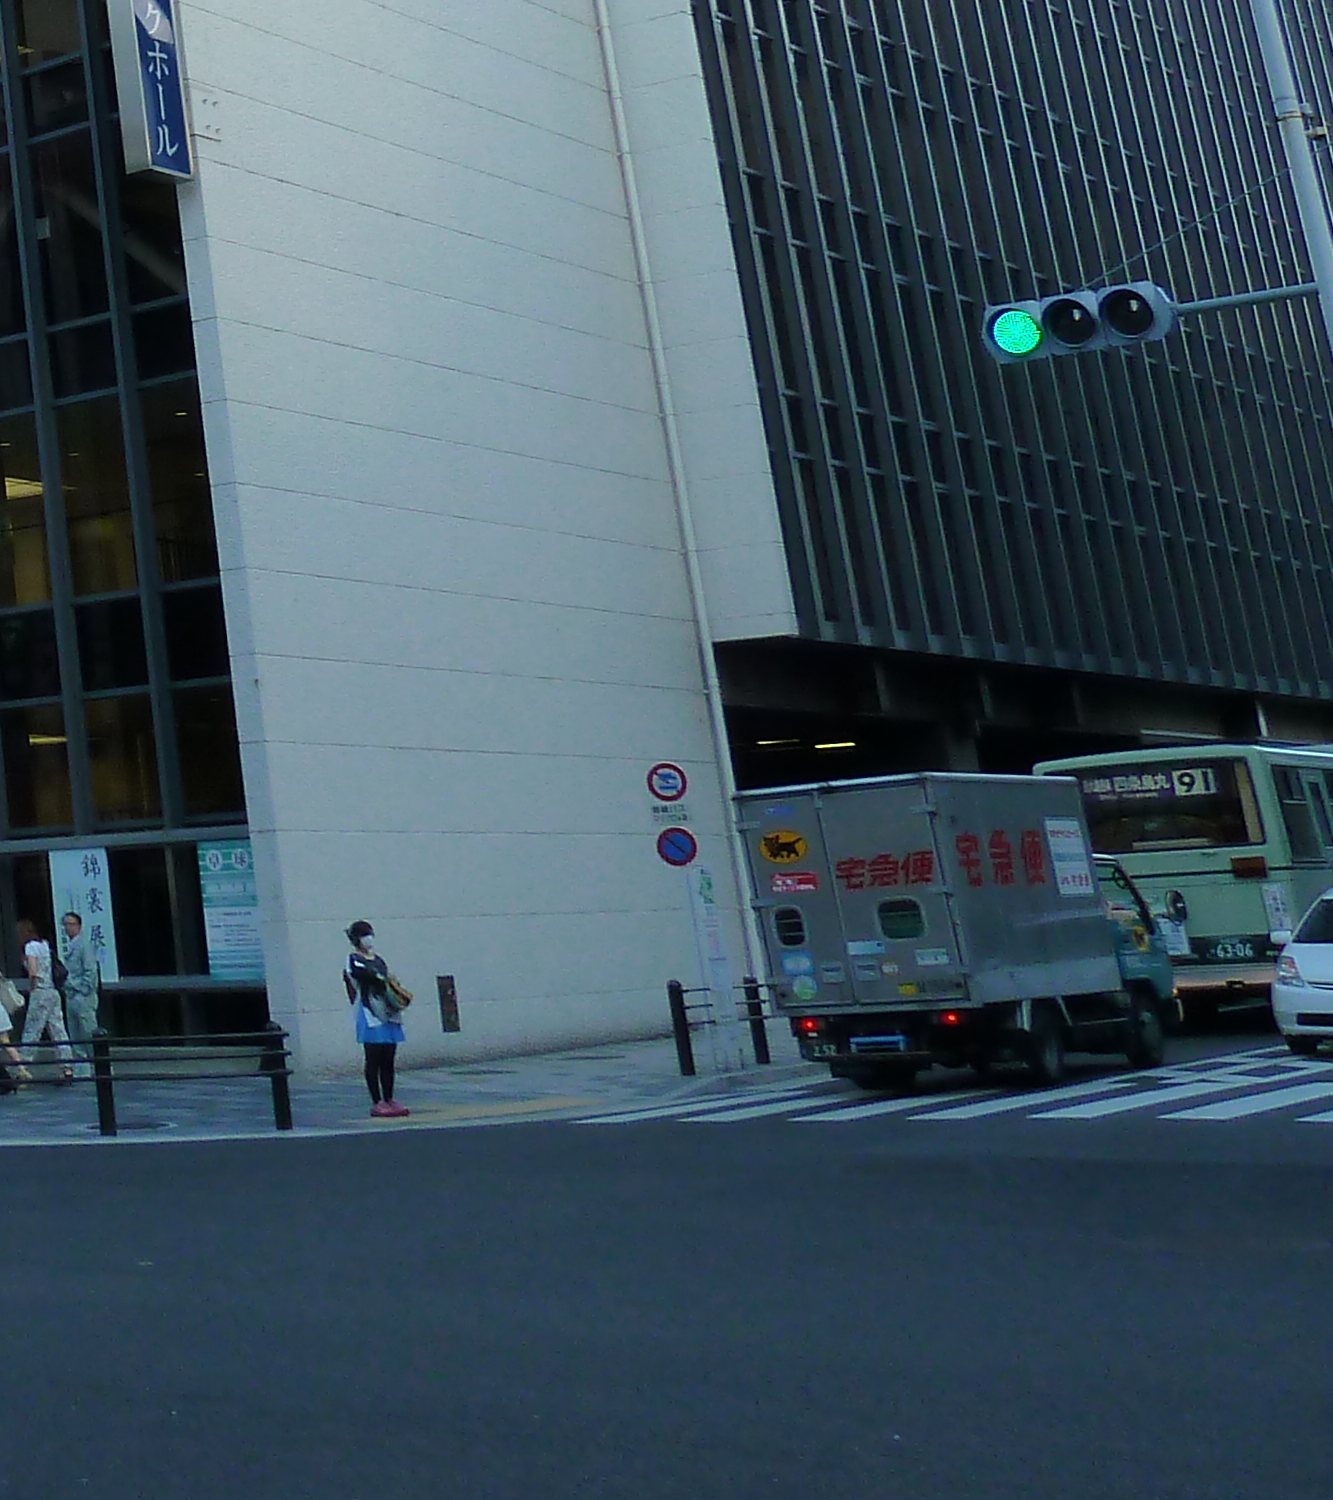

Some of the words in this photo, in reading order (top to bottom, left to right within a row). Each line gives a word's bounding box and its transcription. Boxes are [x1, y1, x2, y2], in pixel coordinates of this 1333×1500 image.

[835, 851, 933, 890] 宅急便
[955, 830, 1046, 887] 宅急便
